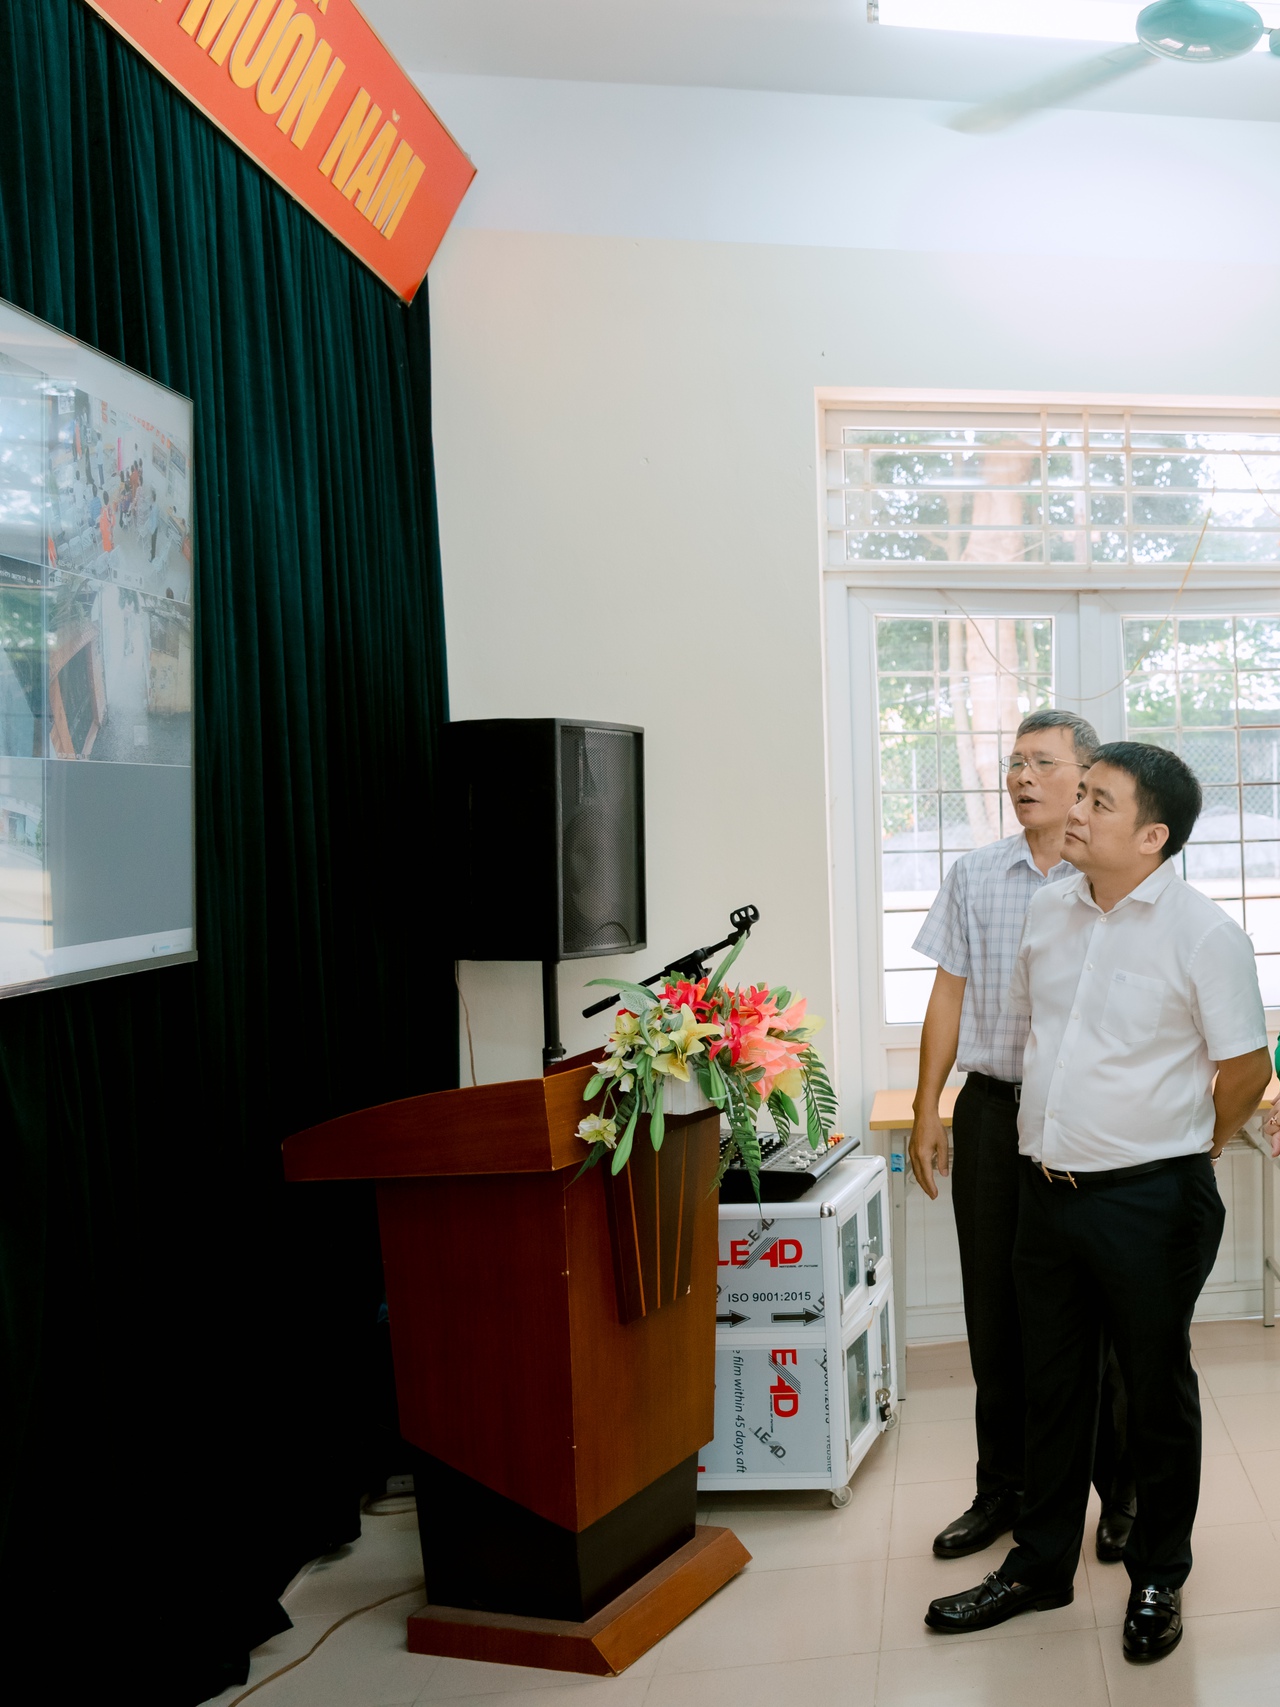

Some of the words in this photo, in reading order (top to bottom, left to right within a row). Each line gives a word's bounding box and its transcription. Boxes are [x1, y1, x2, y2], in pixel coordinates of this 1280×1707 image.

[318, 86, 426, 240] NĂM
[728, 1293, 749, 1303] ISO
[752, 1292, 811, 1302] 9001:2015
[733, 1356, 744, 1377] film
[733, 1378, 745, 1412] within
[735, 1414, 745, 1428] 45
[733, 1430, 746, 1456] days
[753, 1426, 786, 1459] LEAD
